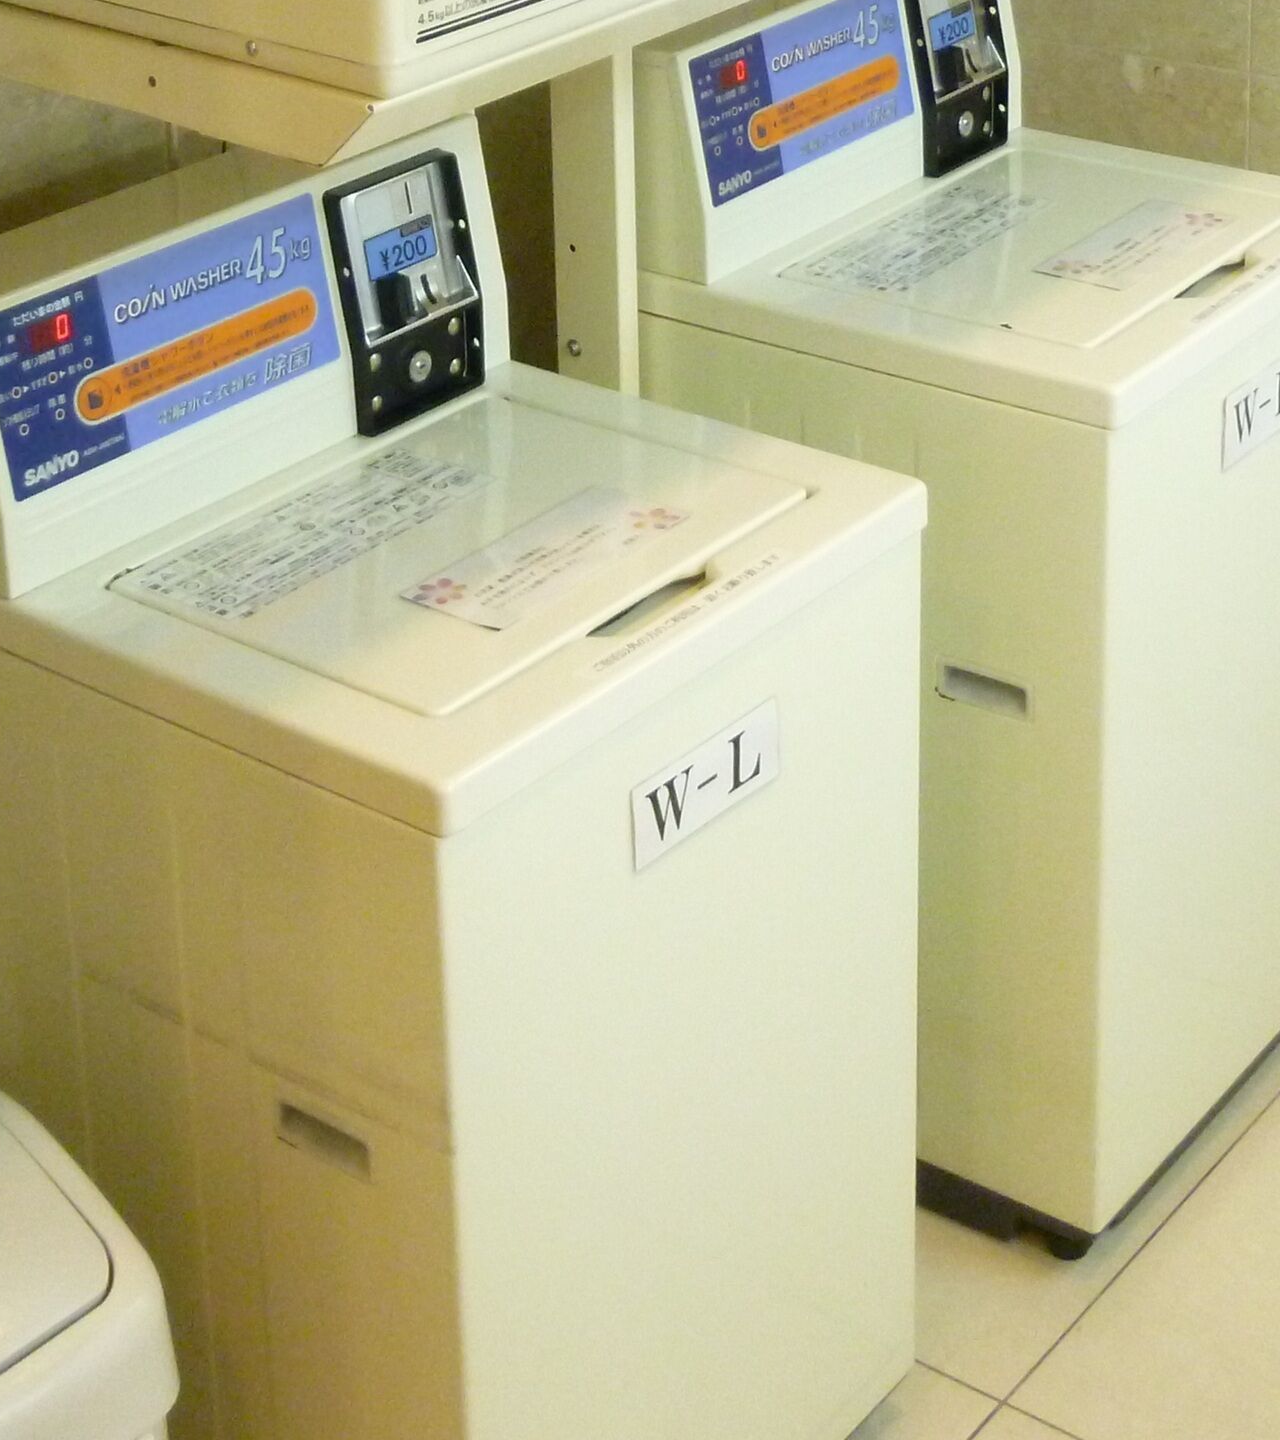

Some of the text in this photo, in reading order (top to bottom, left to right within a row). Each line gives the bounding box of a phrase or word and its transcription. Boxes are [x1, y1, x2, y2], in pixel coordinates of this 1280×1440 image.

[771, 42, 804, 72] COIN
[807, 27, 851, 58] WASHER
[938, 17, 969, 45] ¥200
[735, 60, 746, 81] 0
[718, 170, 752, 196] SANYO
[379, 234, 428, 272] ¥200
[114, 282, 166, 324] COIN
[170, 258, 242, 302] WASHER
[290, 236, 312, 260] kg
[55, 313, 69, 340] 0
[264, 342, 312, 385] 除菌
[23, 449, 80, 487] SANYO
[644, 729, 762, 842] W-L
